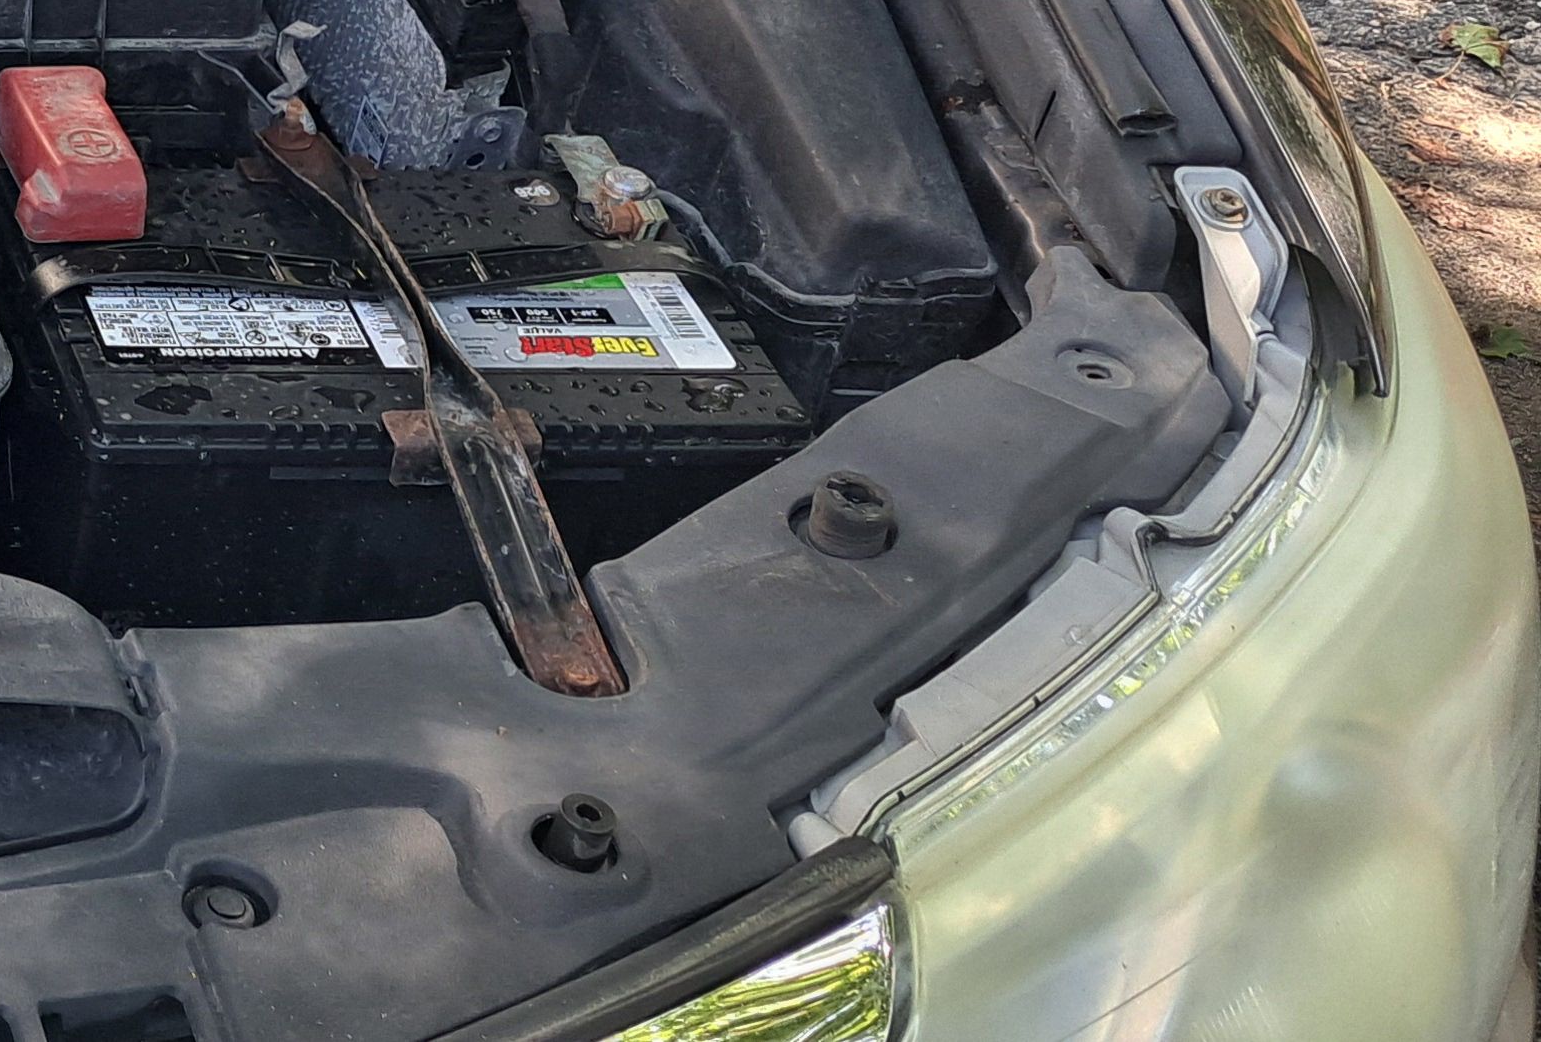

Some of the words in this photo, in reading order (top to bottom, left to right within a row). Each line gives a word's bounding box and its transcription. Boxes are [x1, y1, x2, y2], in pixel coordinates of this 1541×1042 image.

[522, 327, 563, 335] VALUE
[159, 347, 303, 358] DANGER/POISON
[519, 336, 661, 358] EverStart
